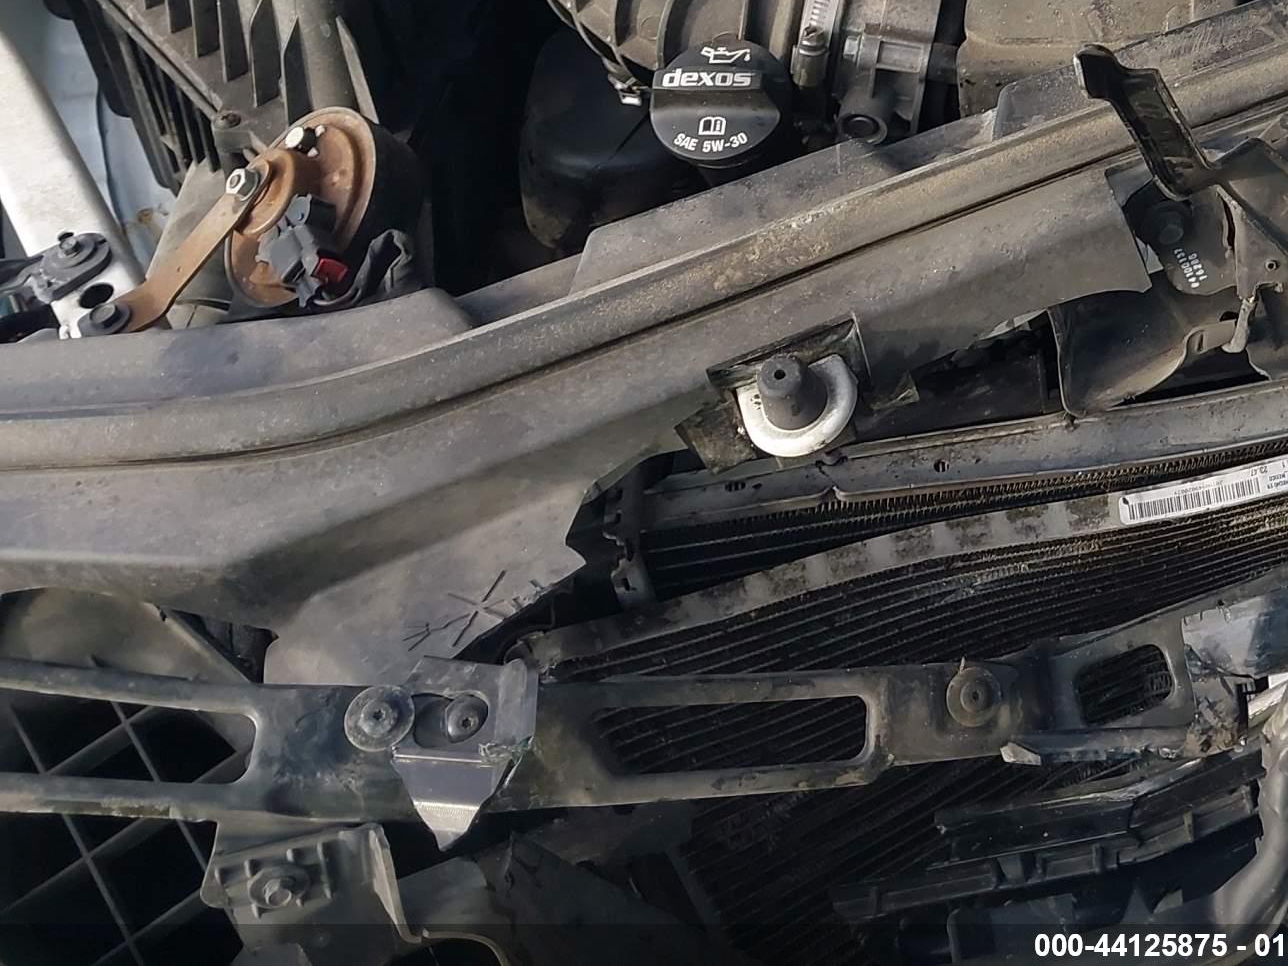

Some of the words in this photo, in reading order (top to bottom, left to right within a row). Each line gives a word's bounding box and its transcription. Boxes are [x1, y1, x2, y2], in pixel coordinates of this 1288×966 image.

[662, 68, 757, 87] dexos
[673, 133, 699, 151] SAE
[701, 132, 749, 153] 5W-30
